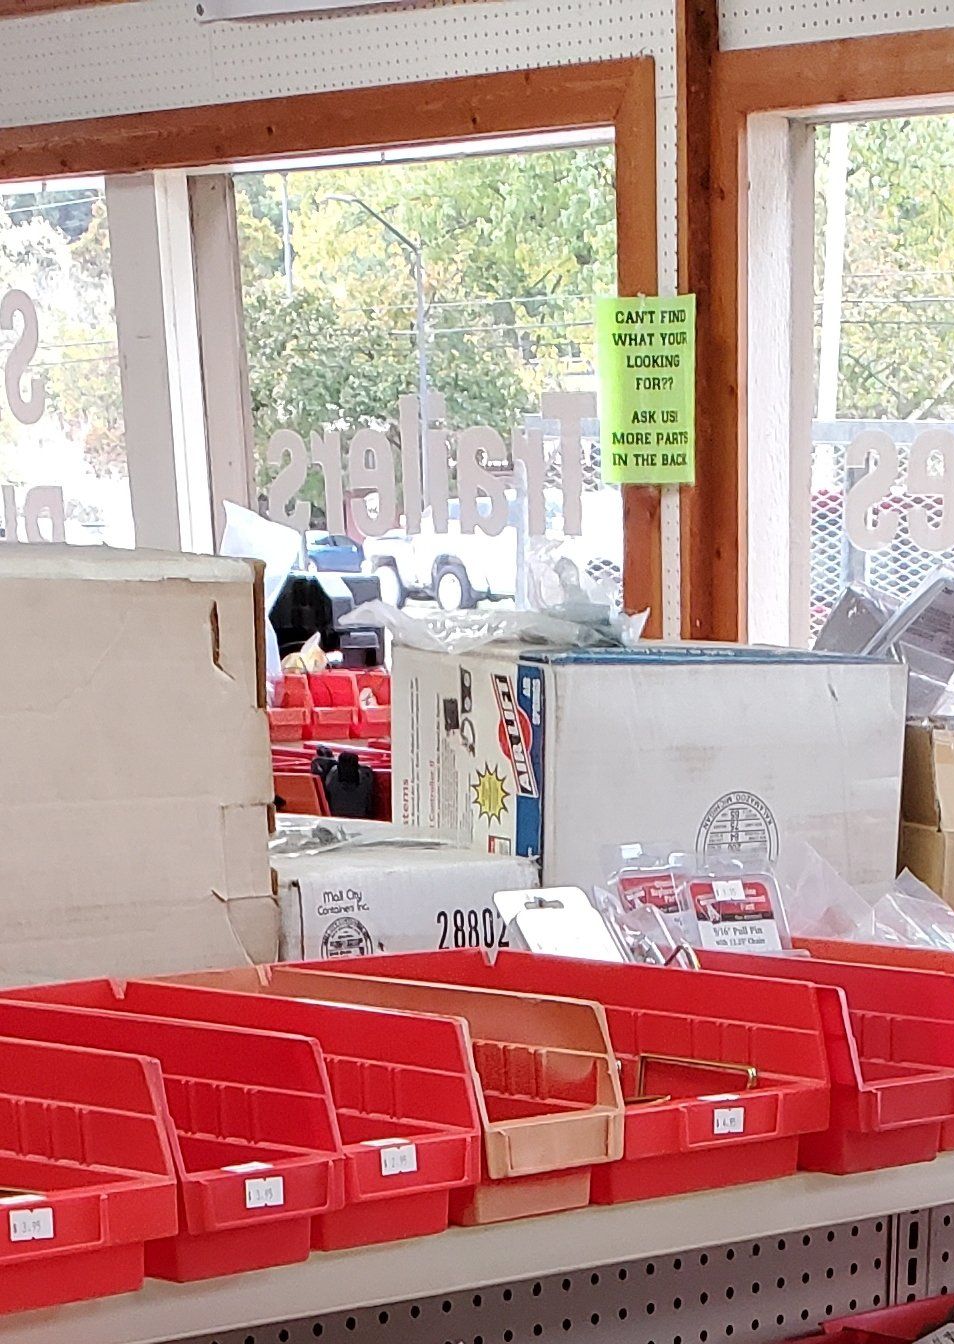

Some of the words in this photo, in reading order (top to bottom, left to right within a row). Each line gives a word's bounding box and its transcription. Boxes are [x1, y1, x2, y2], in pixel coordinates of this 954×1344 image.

[615, 310, 655, 324] CAN'T
[660, 310, 686, 323] FIND
[612, 333, 655, 346] WHAT
[660, 332, 687, 346] YOUR
[626, 354, 680, 368] LOOKING
[636, 377, 673, 390] FOR??
[632, 410, 656, 424] ASK
[661, 410, 678, 424] US!
[612, 432, 652, 445] MORE
[656, 431, 688, 446] PARTS
[612, 453, 628, 466] IN
[633, 453, 657, 466] THE
[661, 453, 687, 466] BACK
[510, 737, 537, 796] AIR
[437, 908, 510, 950] 28802
[733, 927, 748, 935] Pull
